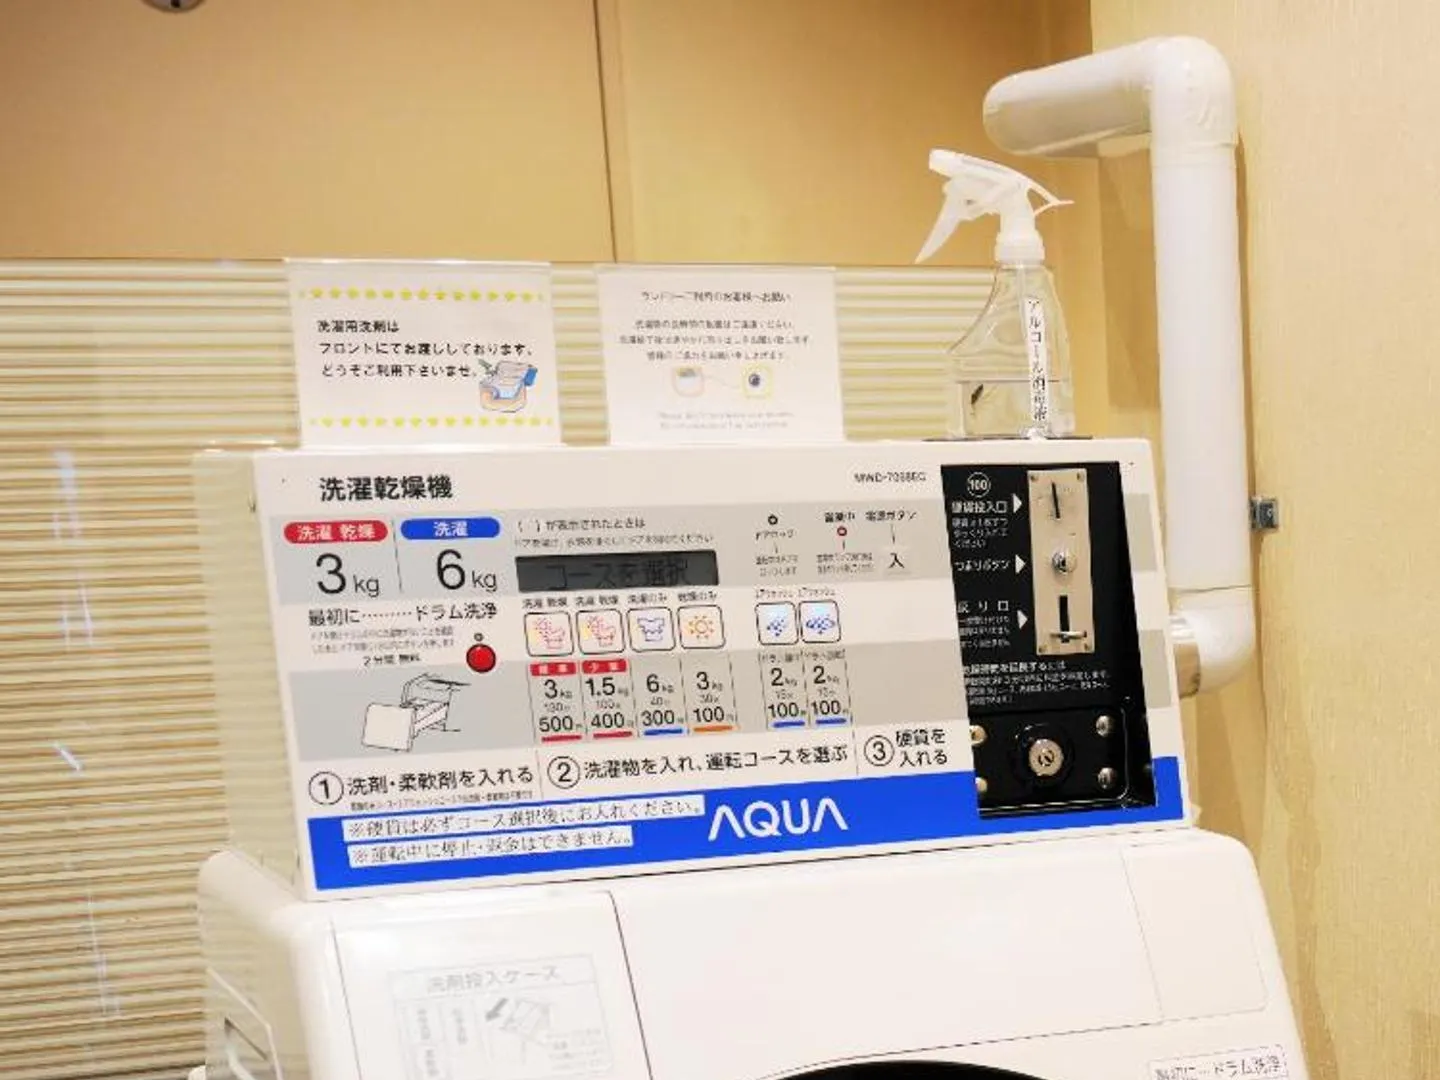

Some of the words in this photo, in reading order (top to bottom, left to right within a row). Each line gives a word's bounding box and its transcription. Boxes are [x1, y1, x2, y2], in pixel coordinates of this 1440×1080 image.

[316, 319, 400, 333] 洗濯用洗剤は
[320, 475, 453, 502] 洗濯乾燥機
[297, 524, 333, 541] 洗濯
[339, 523, 377, 540] 乾燥
[433, 521, 469, 537] 洗濯
[889, 552, 905, 569] 入
[545, 556, 692, 590] コースを選択
[896, 728, 946, 748] 硬貨を
[584, 744, 848, 779] 洗濯物を入れ、運転コースを選ぶ
[899, 747, 949, 768] 入れる
[348, 768, 534, 797] 洗剤・柔軟剤を入れる
[708, 797, 848, 842] AQUA
